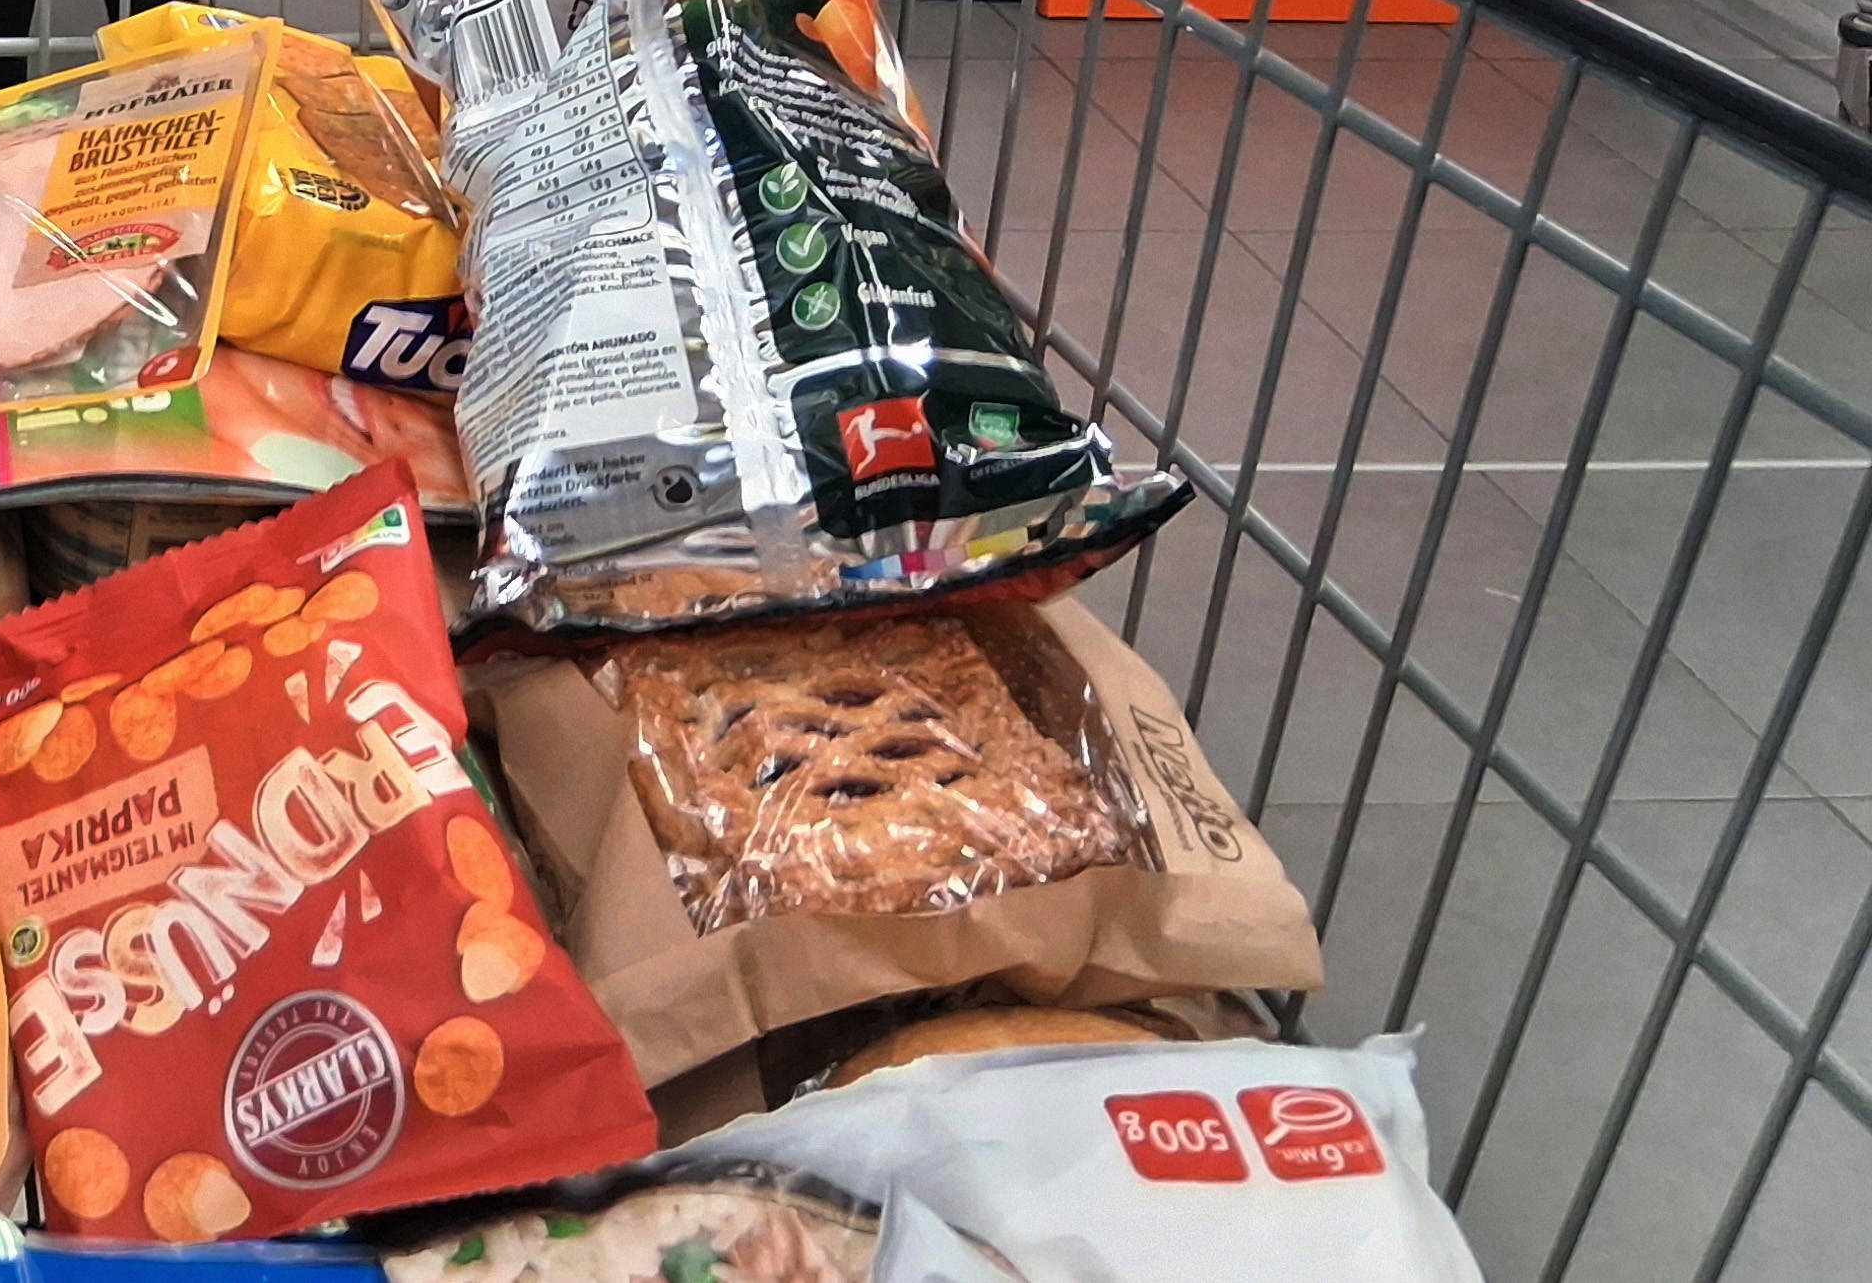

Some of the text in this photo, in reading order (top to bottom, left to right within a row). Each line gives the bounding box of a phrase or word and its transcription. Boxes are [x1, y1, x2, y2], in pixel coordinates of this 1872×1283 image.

[85, 78, 233, 120] HOFMAIER
[69, 127, 220, 173] BRUSTFILET
[78, 110, 225, 150] HÄHNCHEN-
[840, 222, 889, 247] Vegan
[854, 473, 941, 501] BUNDESLIGA
[1129, 704, 1244, 864] Netto
[20, 780, 185, 869] PAPRIKA
[17, 819, 196, 905] IM TEIGMANTEL
[9, 678, 474, 1117] ERDNÜSSE
[237, 1027, 391, 1142] CLARKYS
[296, 1124, 382, 1175] ENJOY
[1118, 1110, 1230, 1152] 500 g
[1322, 1143, 1345, 1172] 6
